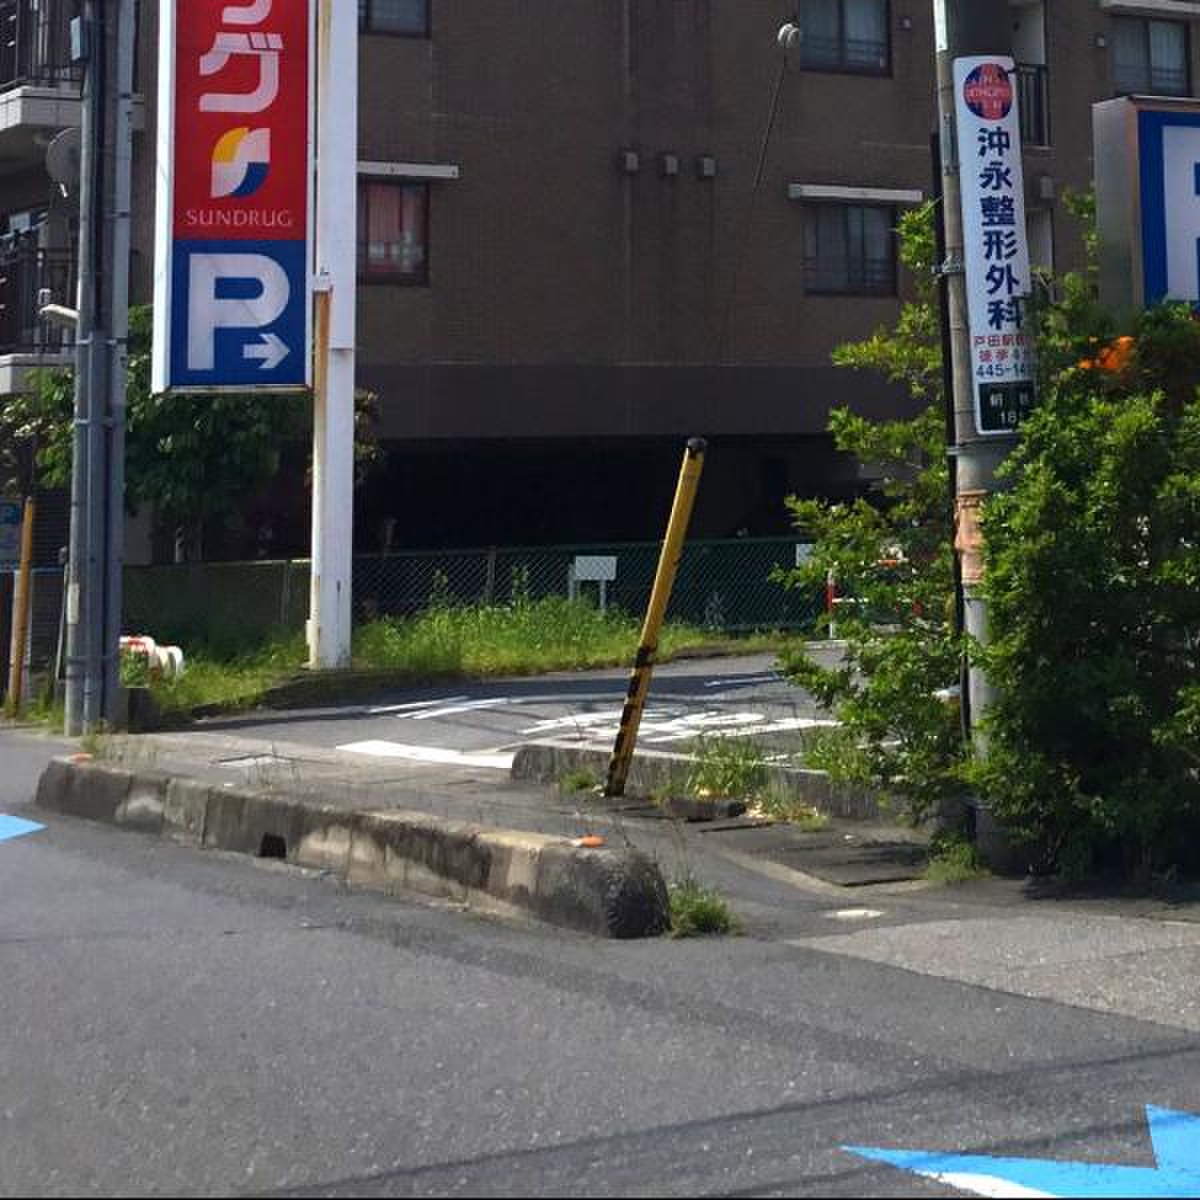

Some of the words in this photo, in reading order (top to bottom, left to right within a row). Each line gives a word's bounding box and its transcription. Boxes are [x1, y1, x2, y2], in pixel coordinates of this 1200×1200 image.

[186, 208, 293, 227] SUNDRUG
[977, 126, 1025, 330] 沖永整形外科
[187, 253, 291, 370] P
